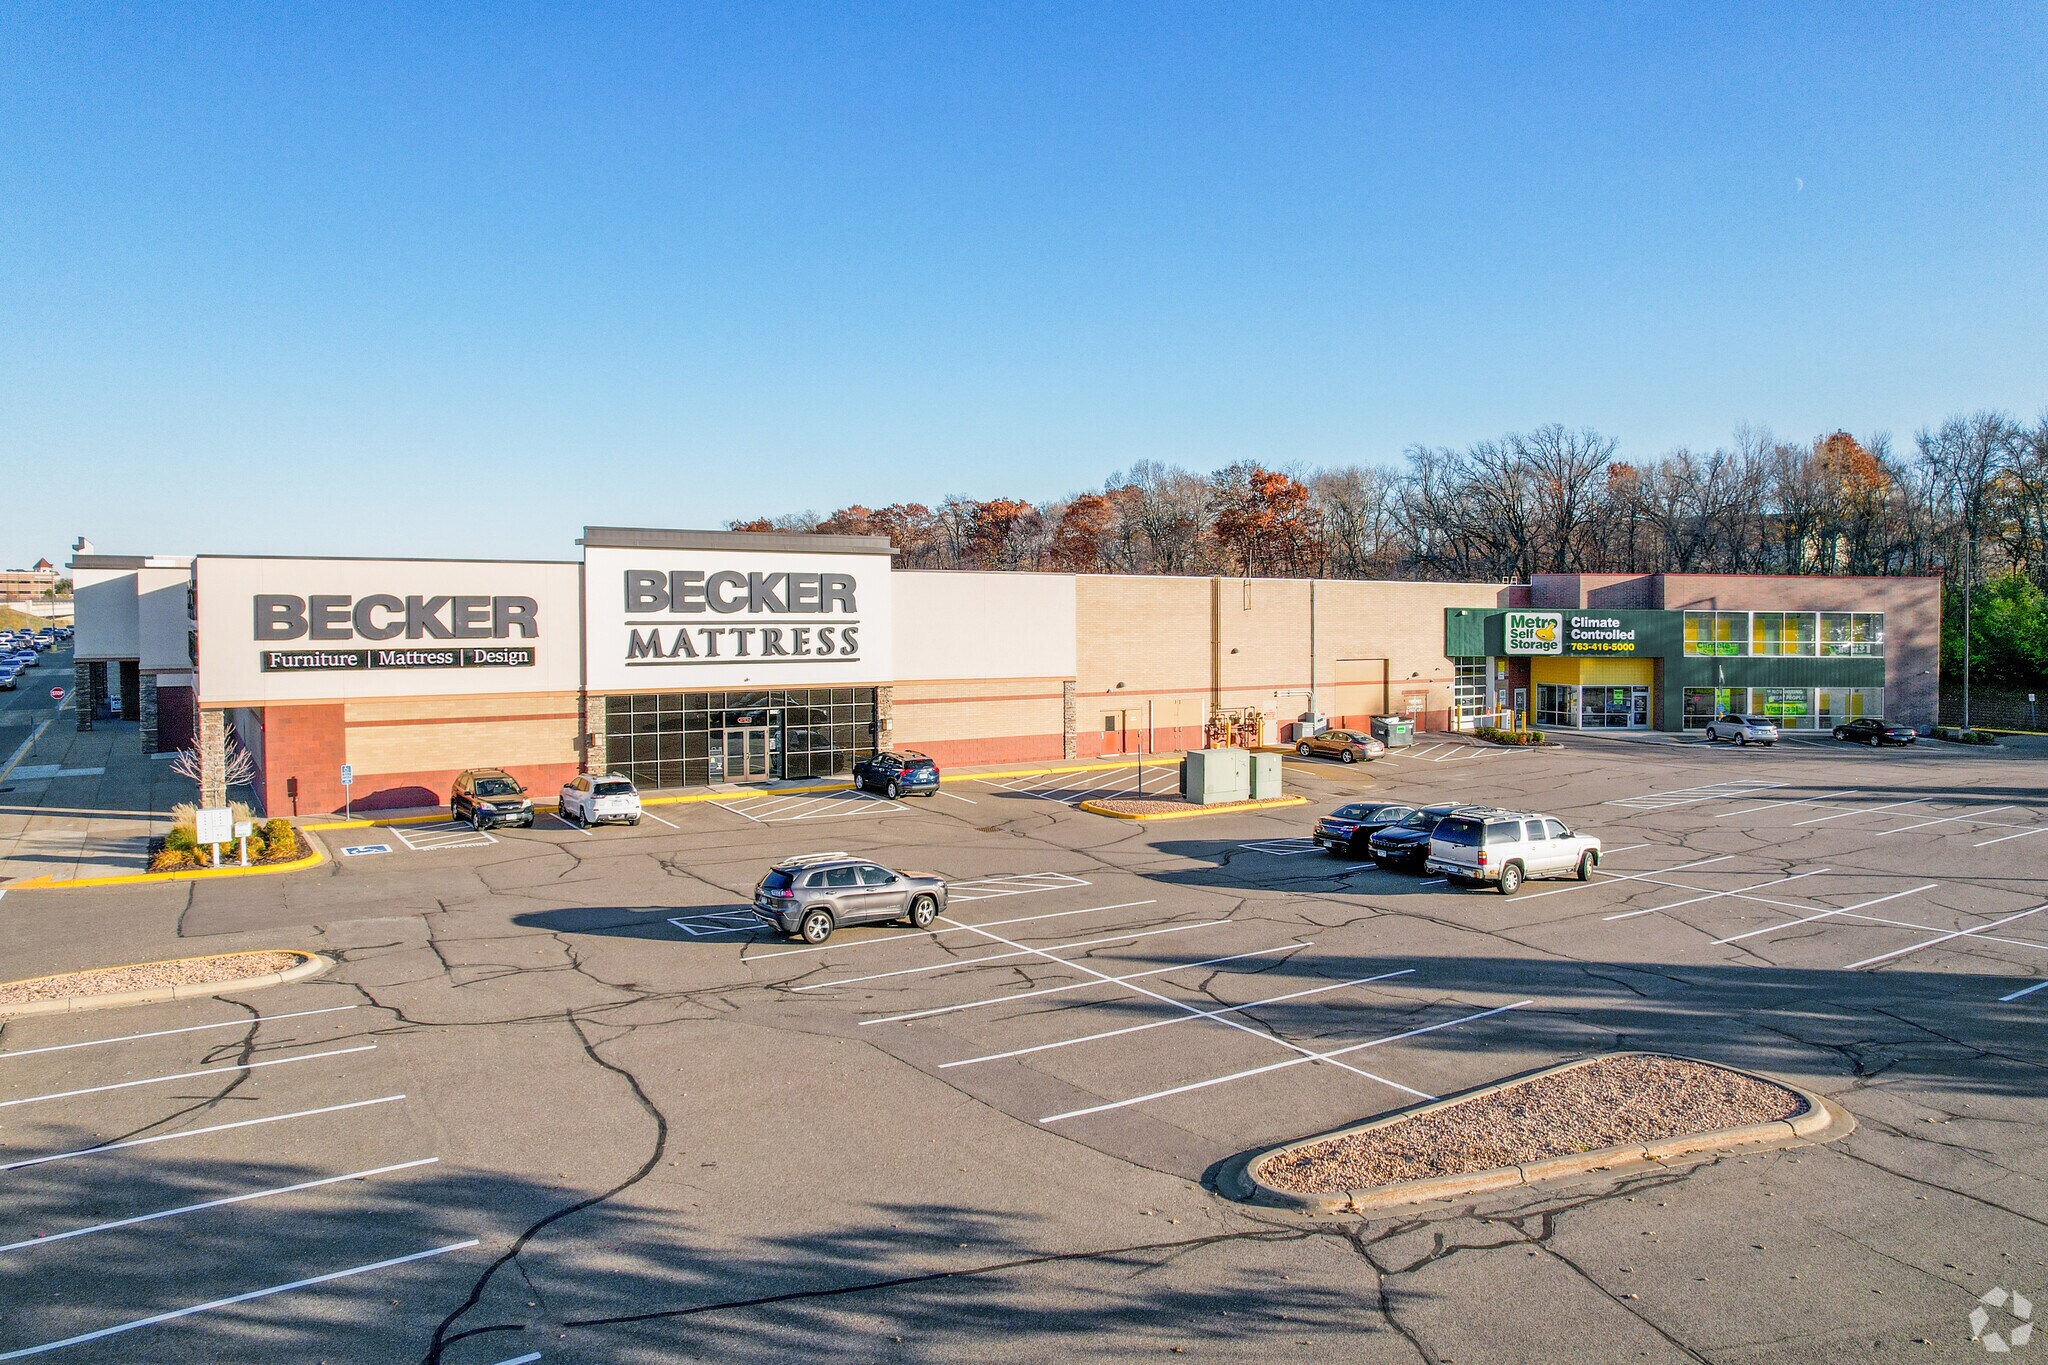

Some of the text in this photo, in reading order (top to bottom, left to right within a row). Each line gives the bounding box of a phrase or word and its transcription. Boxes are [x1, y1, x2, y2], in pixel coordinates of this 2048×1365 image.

[624, 570, 858, 613] BECKER
[253, 594, 540, 641] BECKER
[1510, 615, 1557, 629] Metro
[1571, 617, 1620, 628] Climate
[1510, 629, 1534, 639] Self
[1571, 629, 1635, 640] Controlled
[625, 627, 859, 660] MATTRESS
[1510, 640, 1558, 651] Storage
[1571, 643, 1635, 651] 763-416-5000
[269, 649, 529, 668] Furniture Mattress Design
